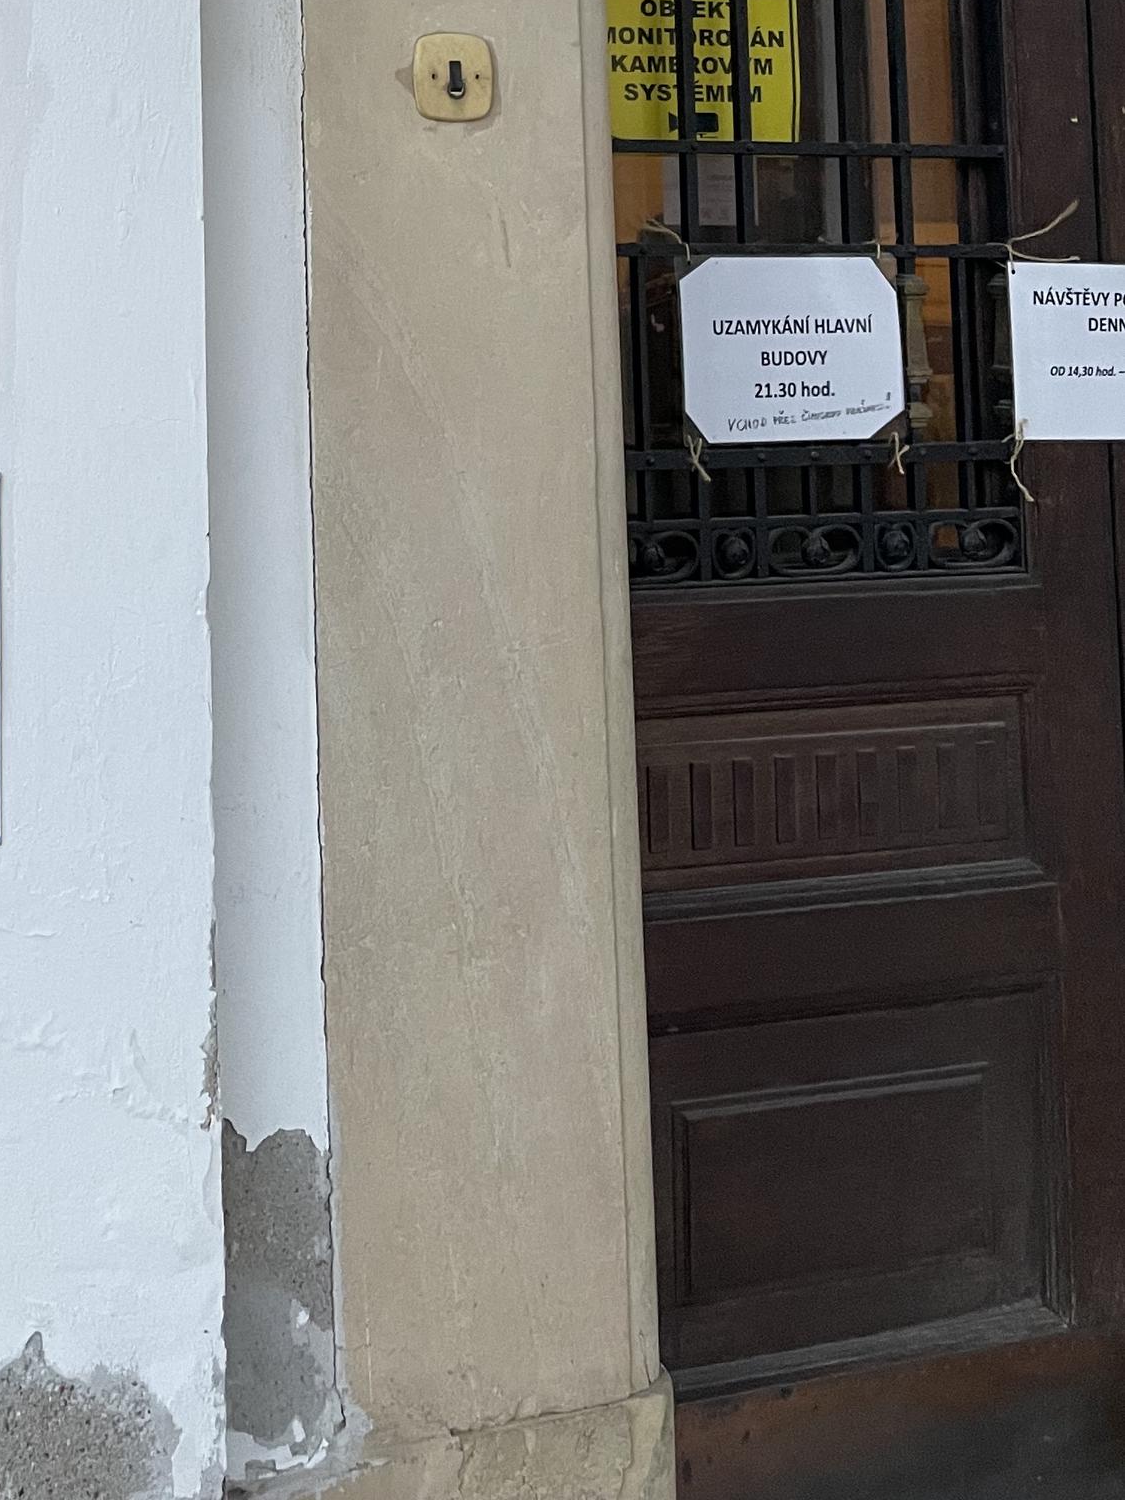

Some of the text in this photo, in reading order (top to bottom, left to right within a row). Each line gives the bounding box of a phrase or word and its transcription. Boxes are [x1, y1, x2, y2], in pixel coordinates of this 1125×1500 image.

[1033, 286, 1111, 307] NÁVŠTĚVY
[712, 313, 873, 336] UZAMYKÁNÍ HLAVNÍ
[760, 350, 828, 367] BUDOVY
[1050, 365, 1066, 377] OD
[1067, 365, 1094, 378] 14,30
[1095, 365, 1117, 377] hod.
[754, 380, 836, 399] 21.30 hod.
